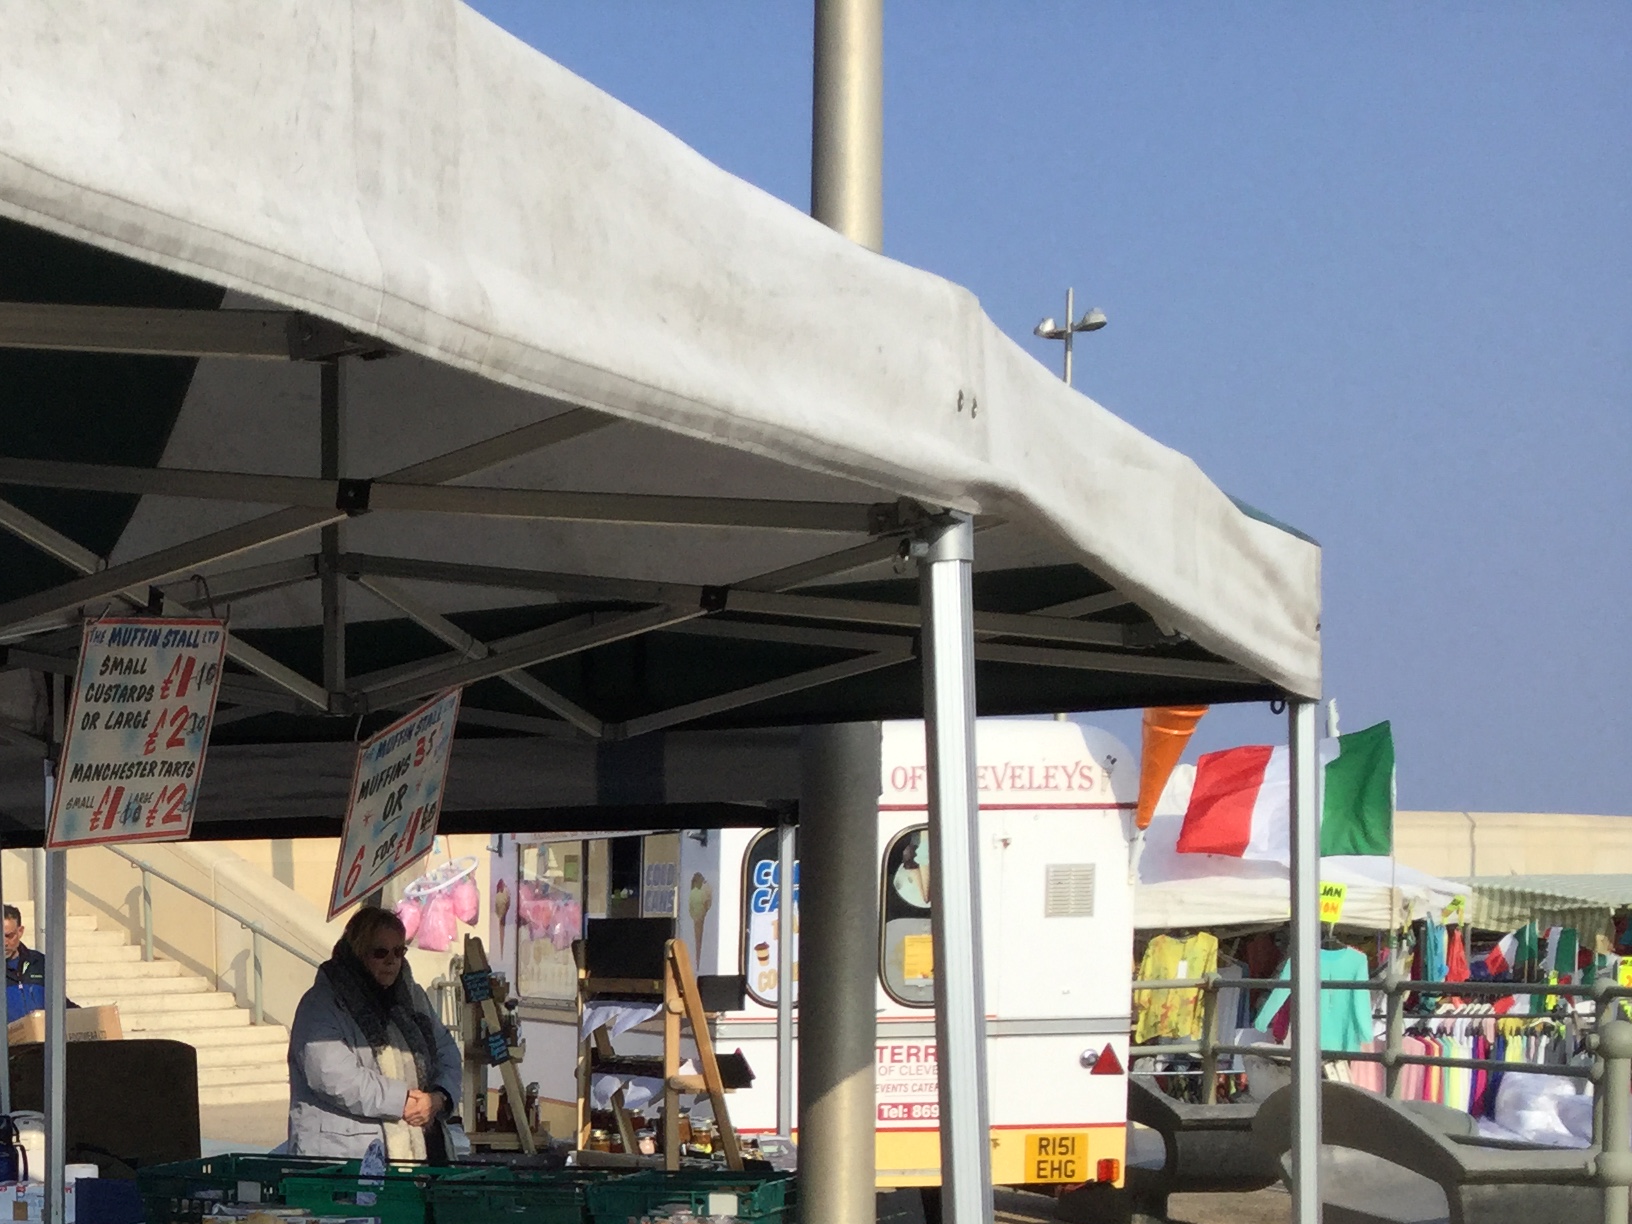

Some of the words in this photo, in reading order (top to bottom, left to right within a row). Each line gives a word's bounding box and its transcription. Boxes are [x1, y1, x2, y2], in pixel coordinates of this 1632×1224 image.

[89, 628, 105, 642] THE
[108, 627, 162, 647] MUFFIN
[162, 628, 200, 648] STALL
[202, 631, 220, 644] LTD
[100, 655, 147, 676] SMALL
[85, 682, 154, 703] CUSTARDS
[81, 711, 101, 731] OR
[104, 710, 151, 731] LARGE
[70, 761, 157, 783] MANCHESTER
[158, 760, 196, 778] TARTS
[357, 753, 411, 804] MUFFINS
[891, 765, 926, 791] OF
[66, 795, 95, 810] SMALL
[382, 783, 409, 822] OR
[344, 845, 366, 898] 6
[372, 832, 398, 867] FOR
[878, 1065, 897, 1076] OF
[881, 1104, 908, 1118] Tel:
[1036, 1159, 1076, 1179] EHG
